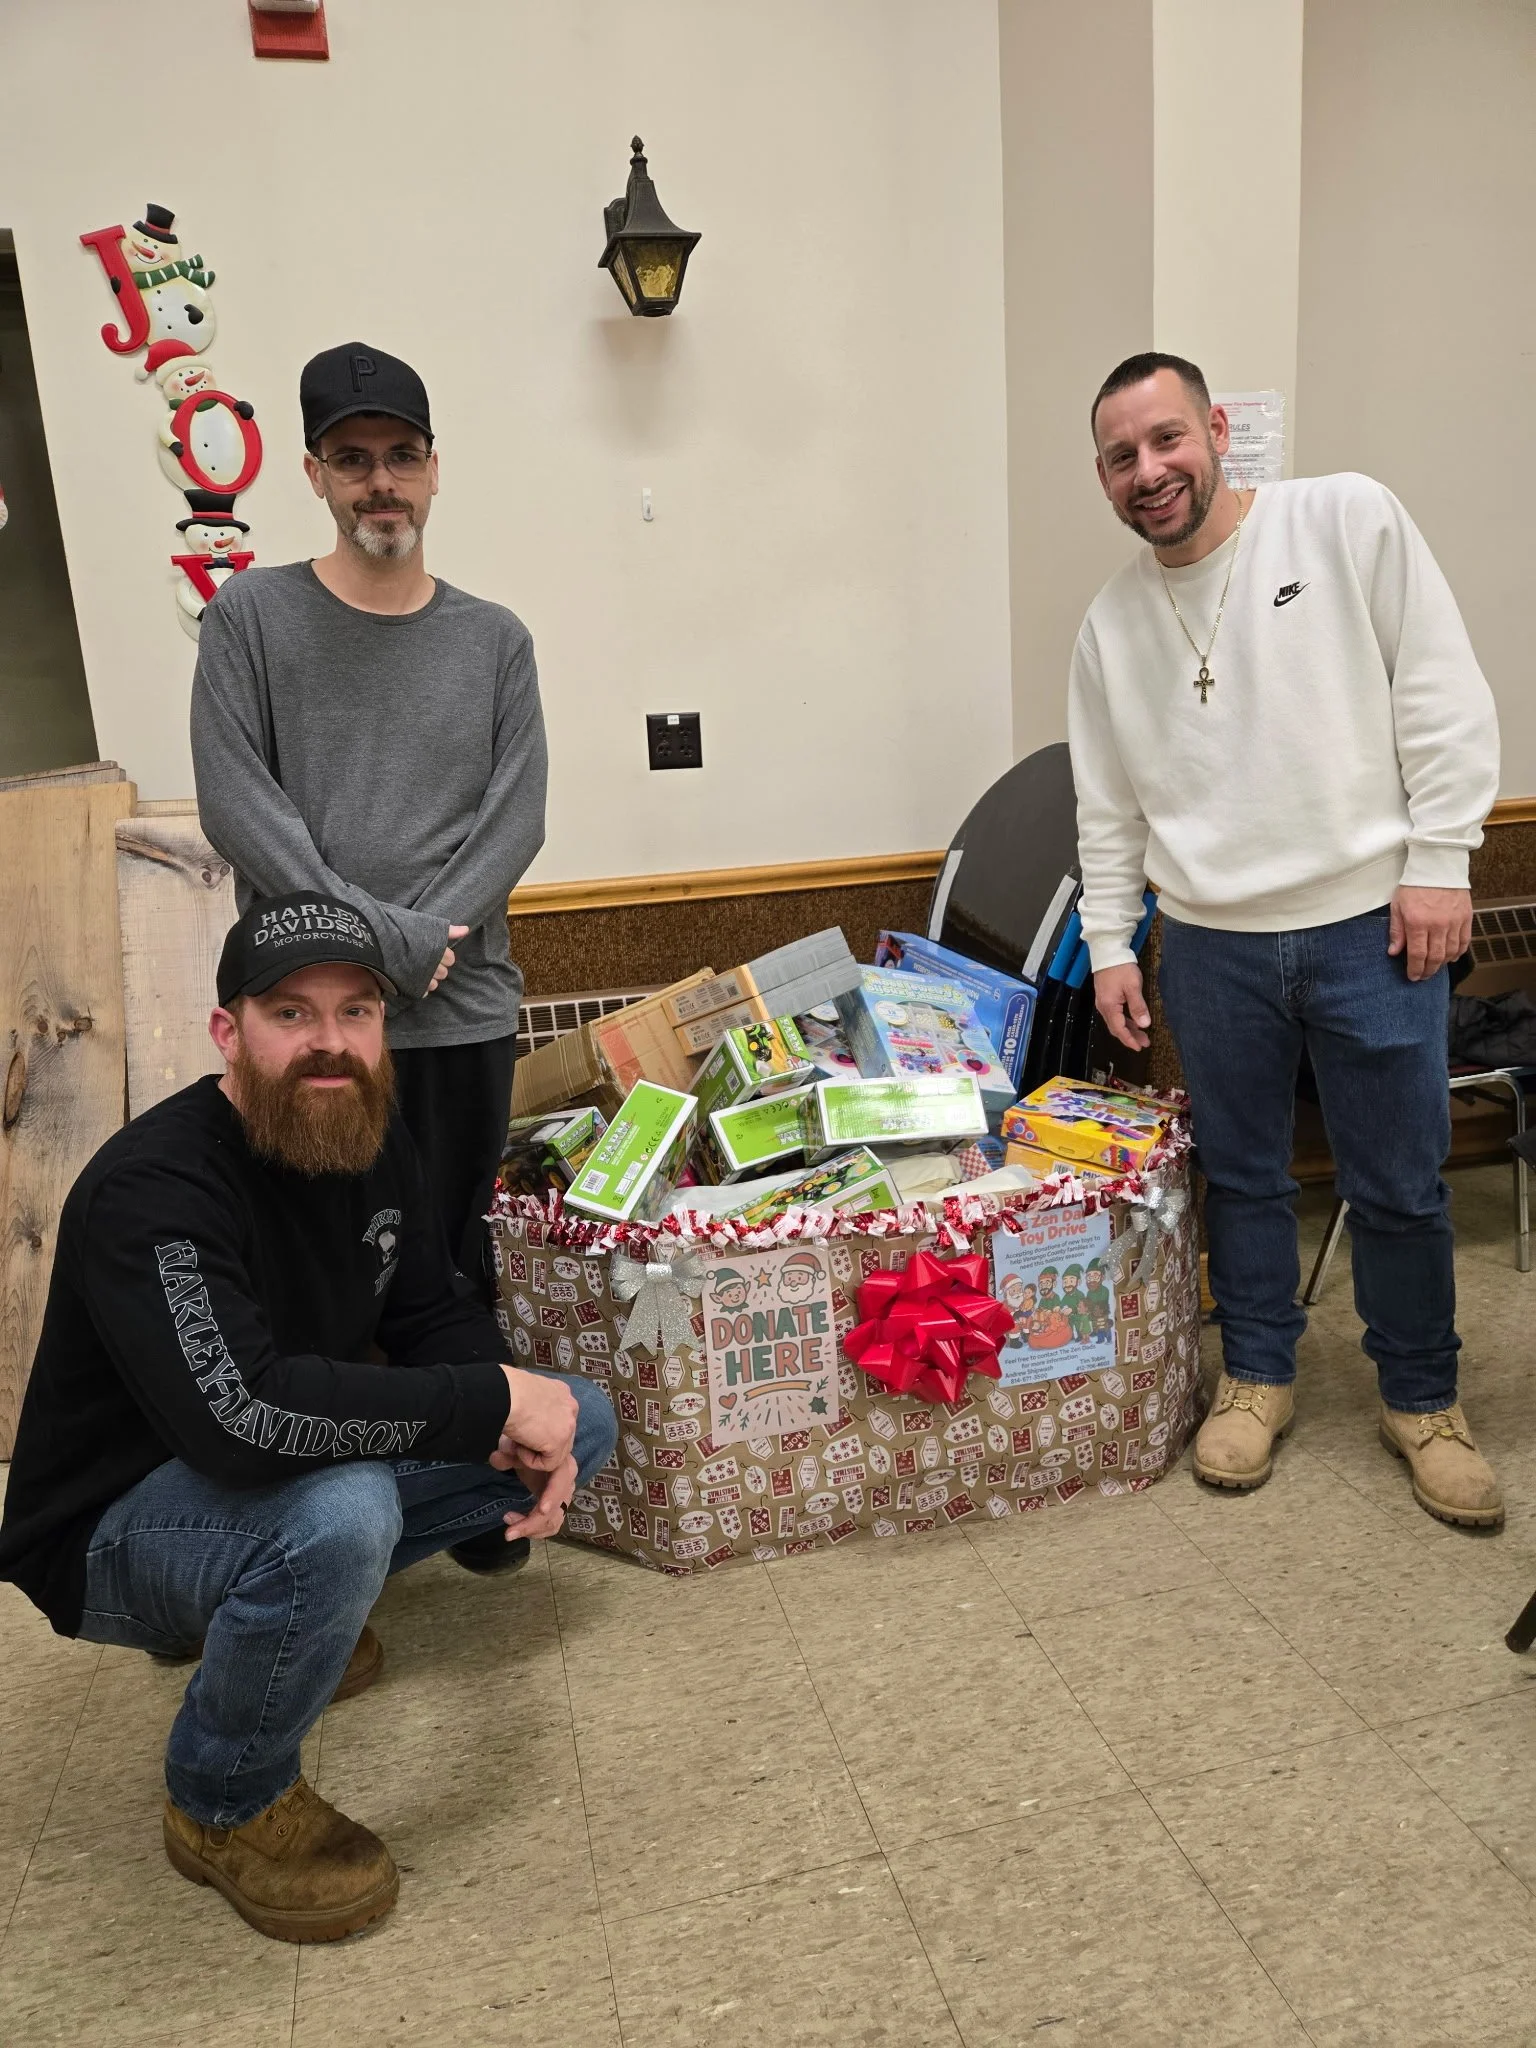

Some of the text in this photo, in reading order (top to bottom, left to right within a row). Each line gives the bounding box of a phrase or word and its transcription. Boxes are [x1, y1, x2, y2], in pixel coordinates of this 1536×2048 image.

[349, 355, 377, 393] P
[1278, 581, 1301, 599] NIKE
[254, 917, 375, 948] DAVIDSON
[273, 932, 364, 949] MOTORCYCLES
[1003, 1038, 1017, 1055] 10
[1032, 1214, 1058, 1229] Zen
[1019, 1231, 1044, 1247] Toy
[1048, 1223, 1087, 1240] Drive
[1006, 1248, 1033, 1259] Accepting
[711, 1301, 830, 1351] DONATE
[725, 1337, 824, 1387] HERE
[1037, 1350, 1058, 1359] contact
